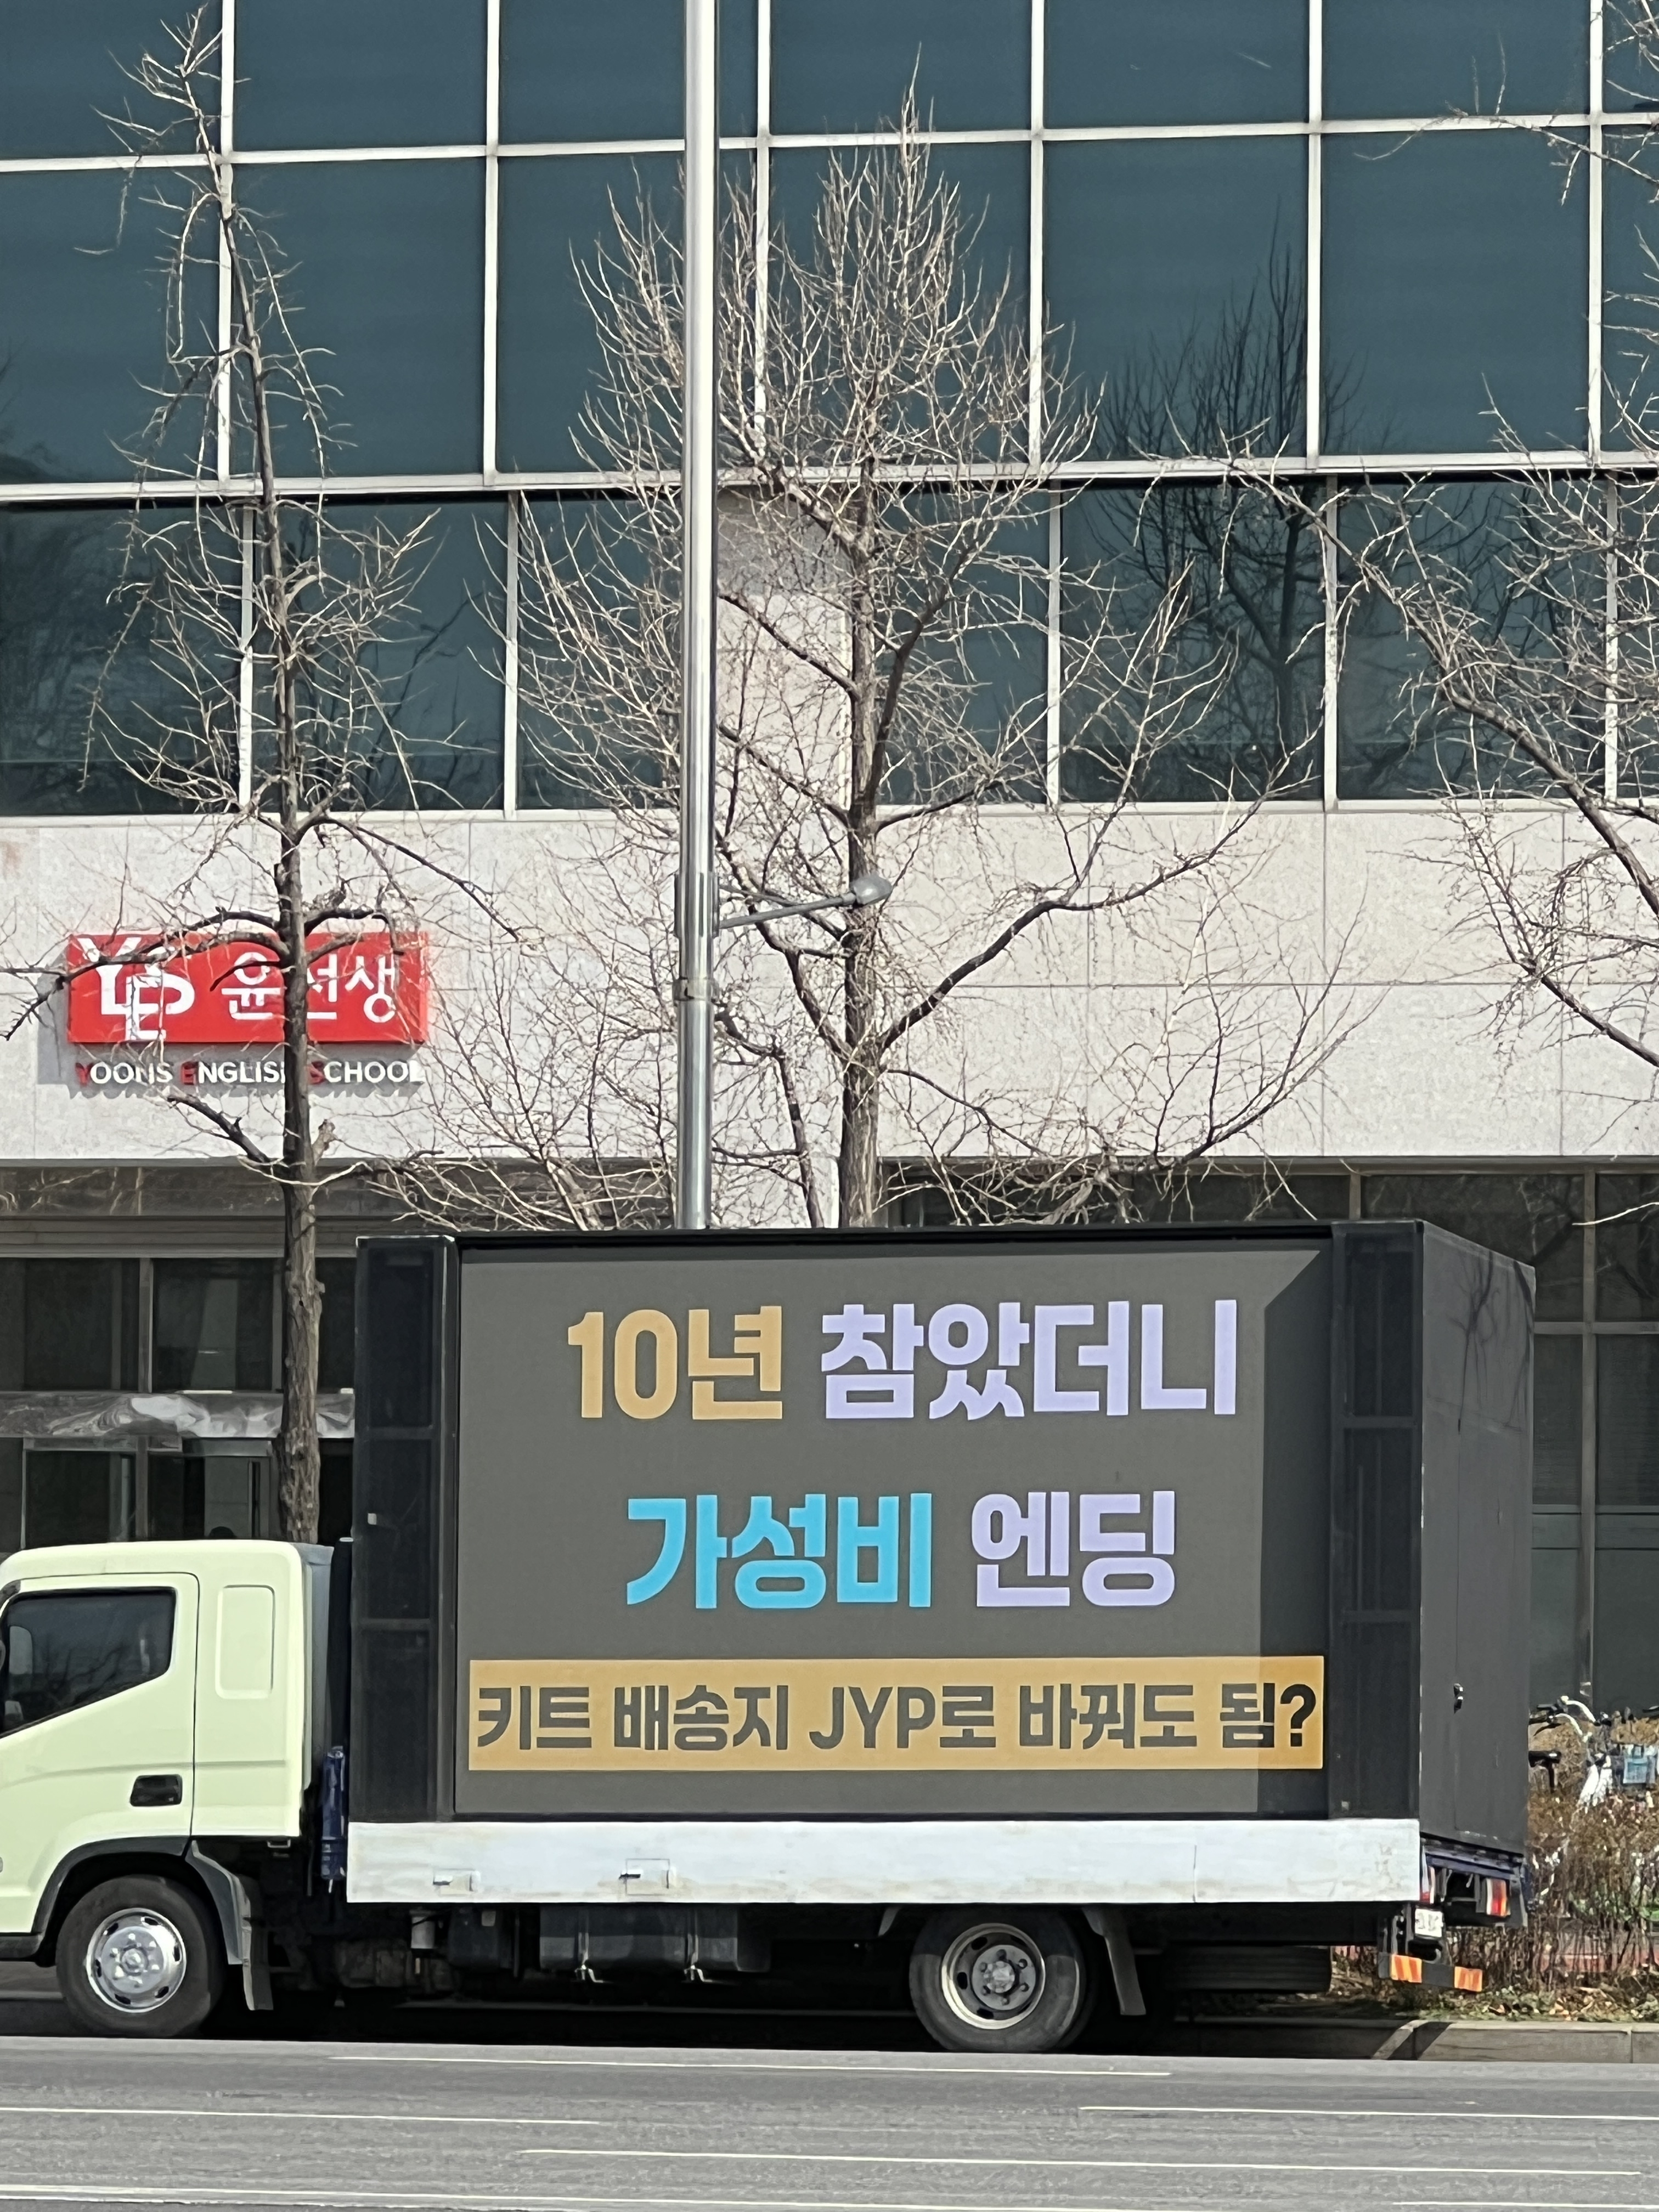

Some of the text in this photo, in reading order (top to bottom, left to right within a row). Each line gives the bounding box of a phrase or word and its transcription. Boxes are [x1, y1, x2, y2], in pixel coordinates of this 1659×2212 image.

[75, 1060, 426, 1086] YOONS ENGLIS SCHOOL
[567, 1299, 1238, 1421] 10년 참았더니
[626, 1490, 1176, 1610] 가성비 엔딩
[477, 1682, 1317, 1752] 키트 배송지 JYP로 바꿔도 됨?
